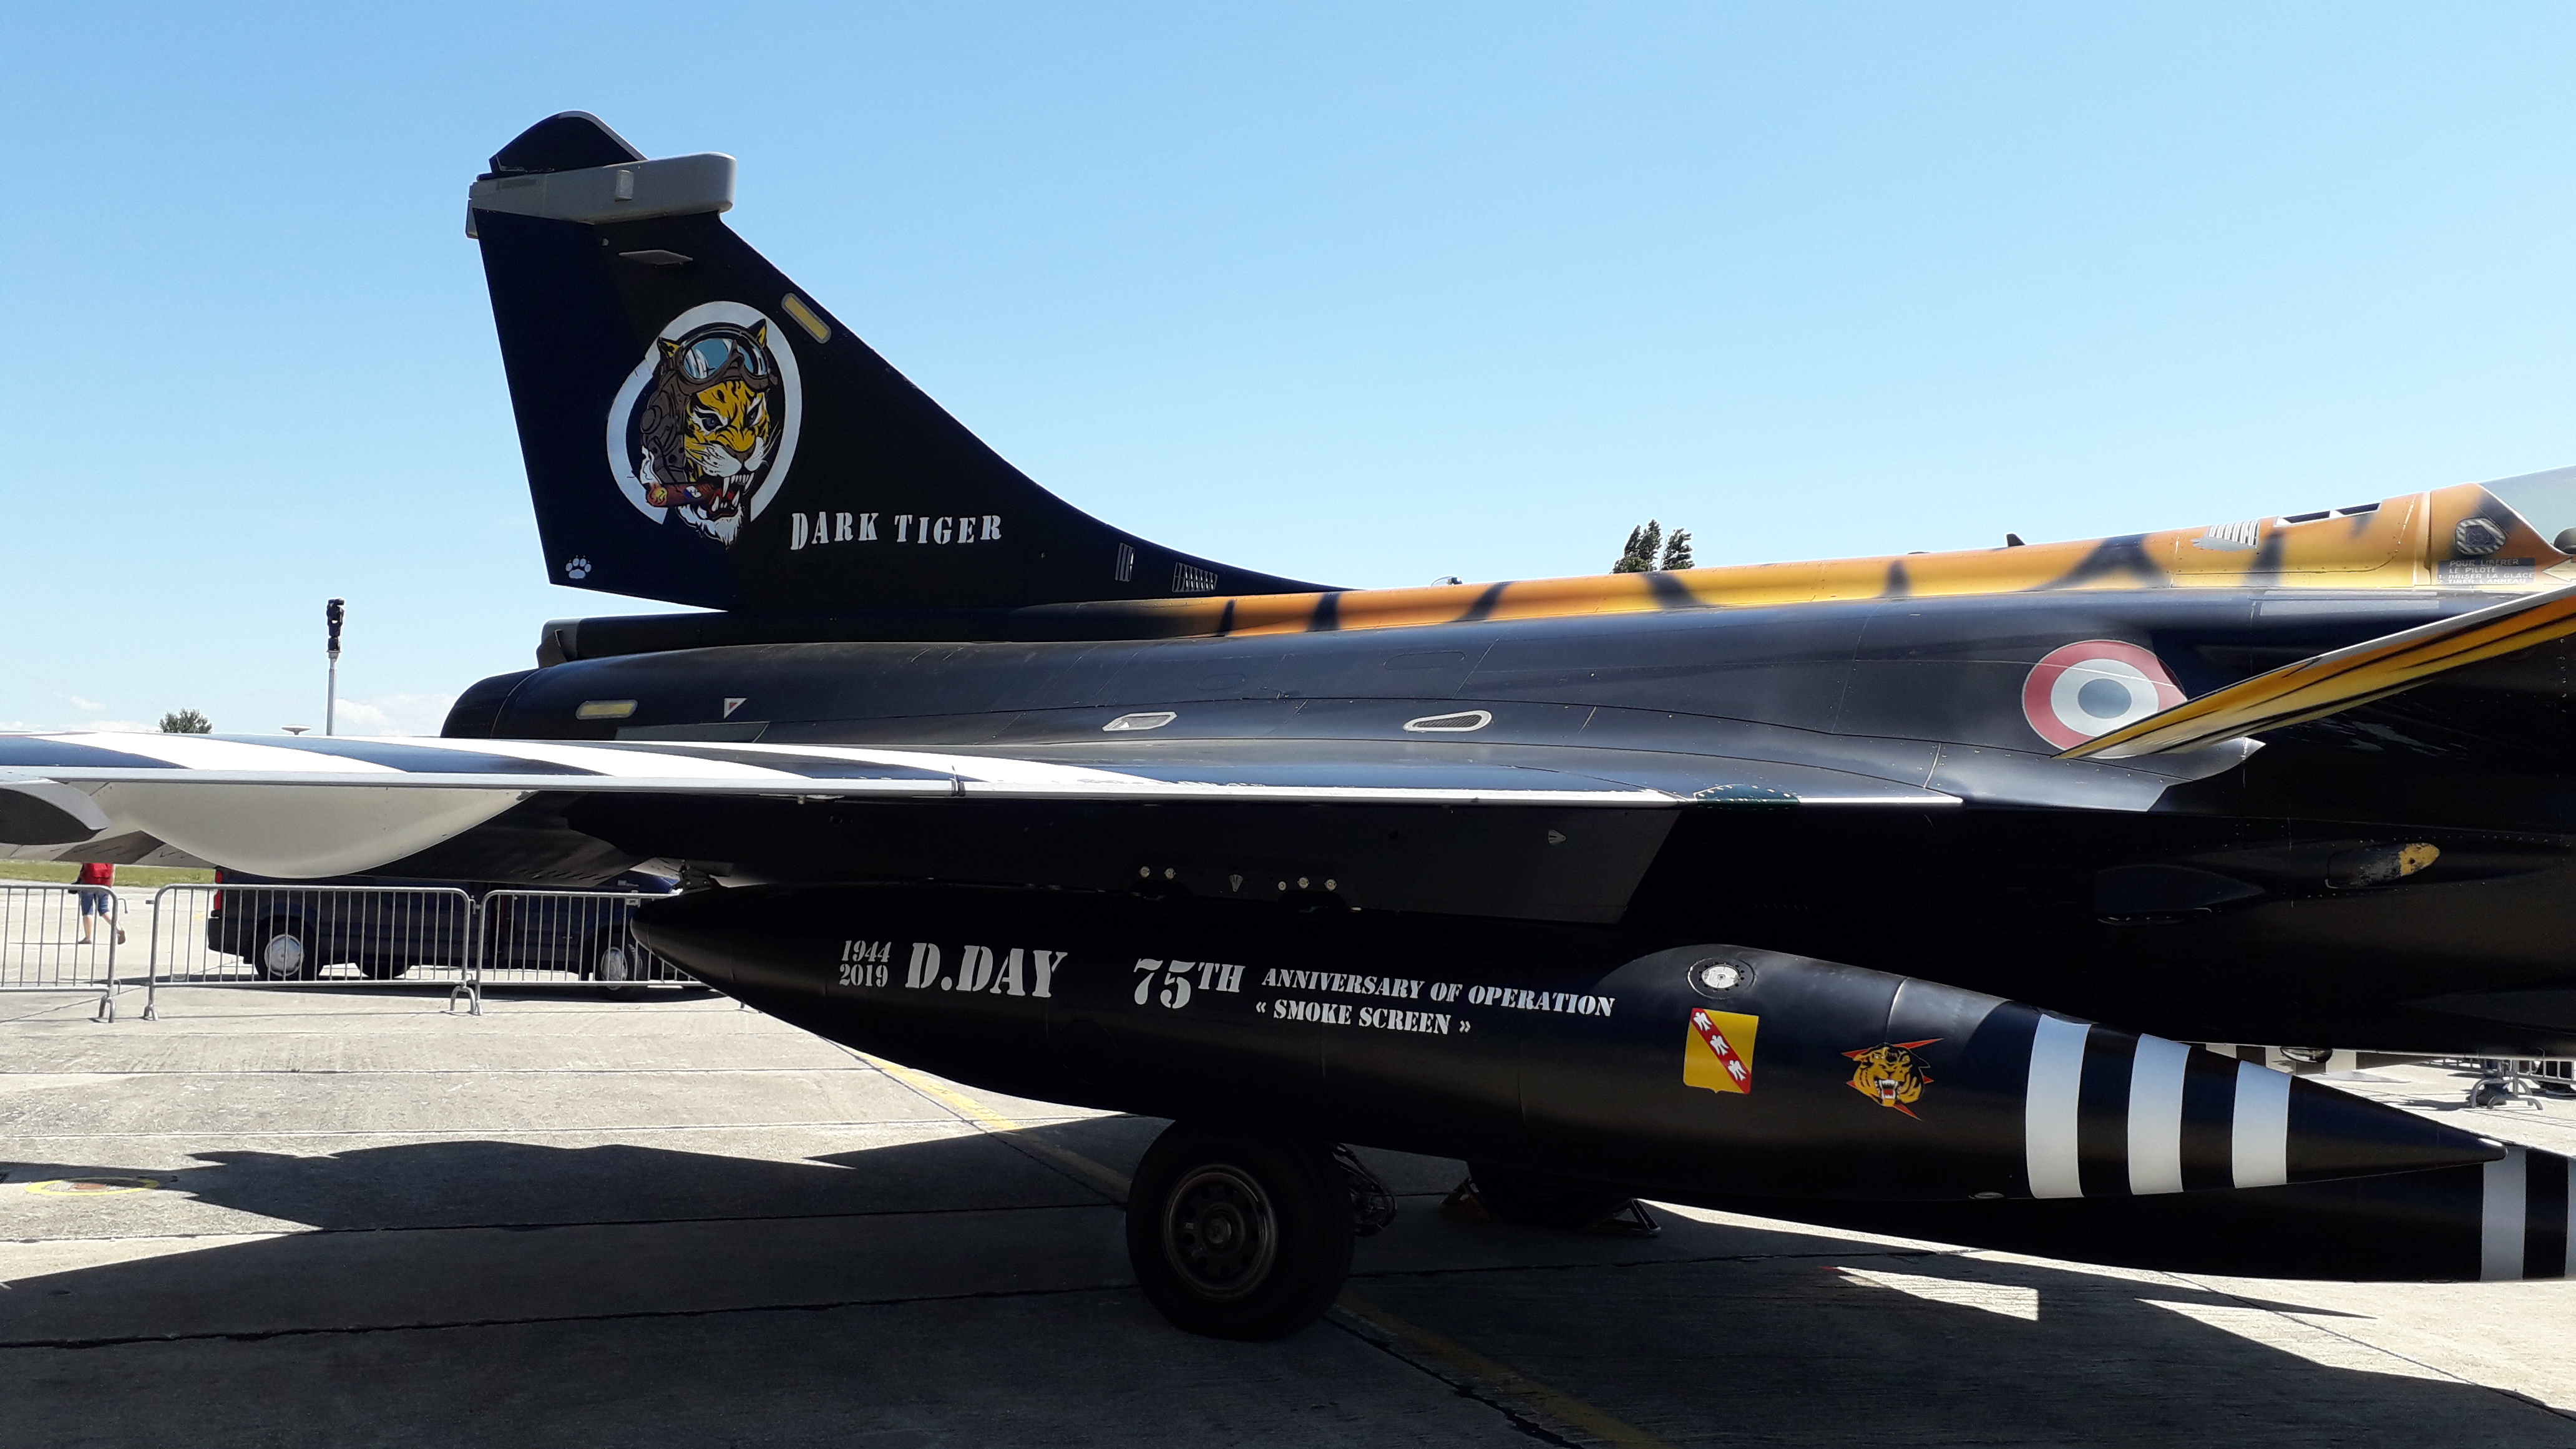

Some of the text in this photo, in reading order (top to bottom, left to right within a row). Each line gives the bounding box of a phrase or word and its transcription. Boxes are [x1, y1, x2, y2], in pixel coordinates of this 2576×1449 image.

[790, 511, 1002, 550] DARK TIGER
[841, 940, 892, 963] 1944
[839, 964, 888, 987] 2019
[905, 942, 1246, 1009] D.DAY 75TH
[1261, 968, 1616, 1017] ANNIVERSARY OF OPERATION
